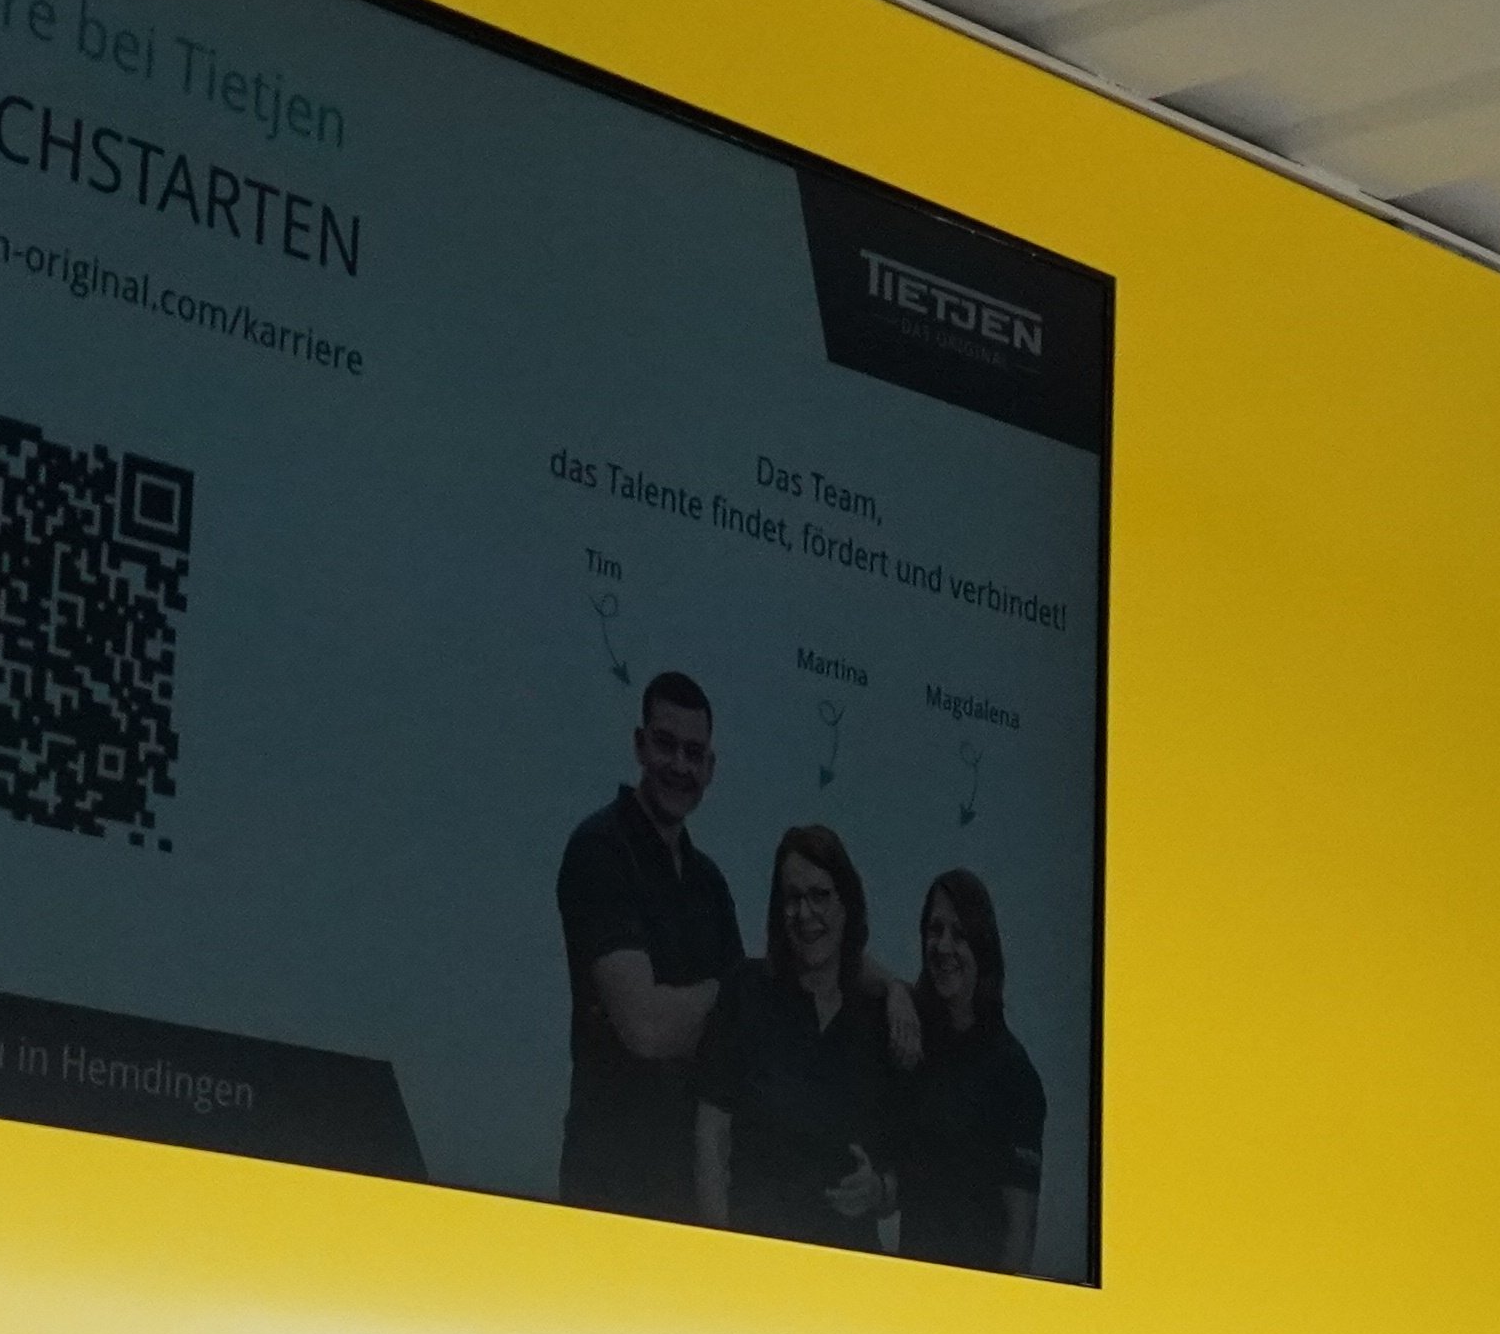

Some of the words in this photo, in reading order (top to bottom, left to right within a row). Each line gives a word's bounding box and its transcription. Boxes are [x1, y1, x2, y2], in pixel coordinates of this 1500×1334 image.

[173, 34, 347, 150] Tietjen
[860, 247, 1044, 357] TIETJEN
[755, 454, 804, 498] Das
[810, 470, 883, 527] Team,
[550, 447, 599, 491] das
[608, 461, 704, 523] Talente
[711, 494, 793, 552] findet,
[801, 521, 890, 579] fördert
[896, 555, 942, 595] und
[948, 572, 1068, 634] verbindet!
[585, 546, 624, 582] Tim
[796, 645, 870, 690] Martina
[925, 681, 1022, 732] Magdalena
[16, 1038, 50, 1080] in
[60, 1043, 256, 1115] Hemdingen
